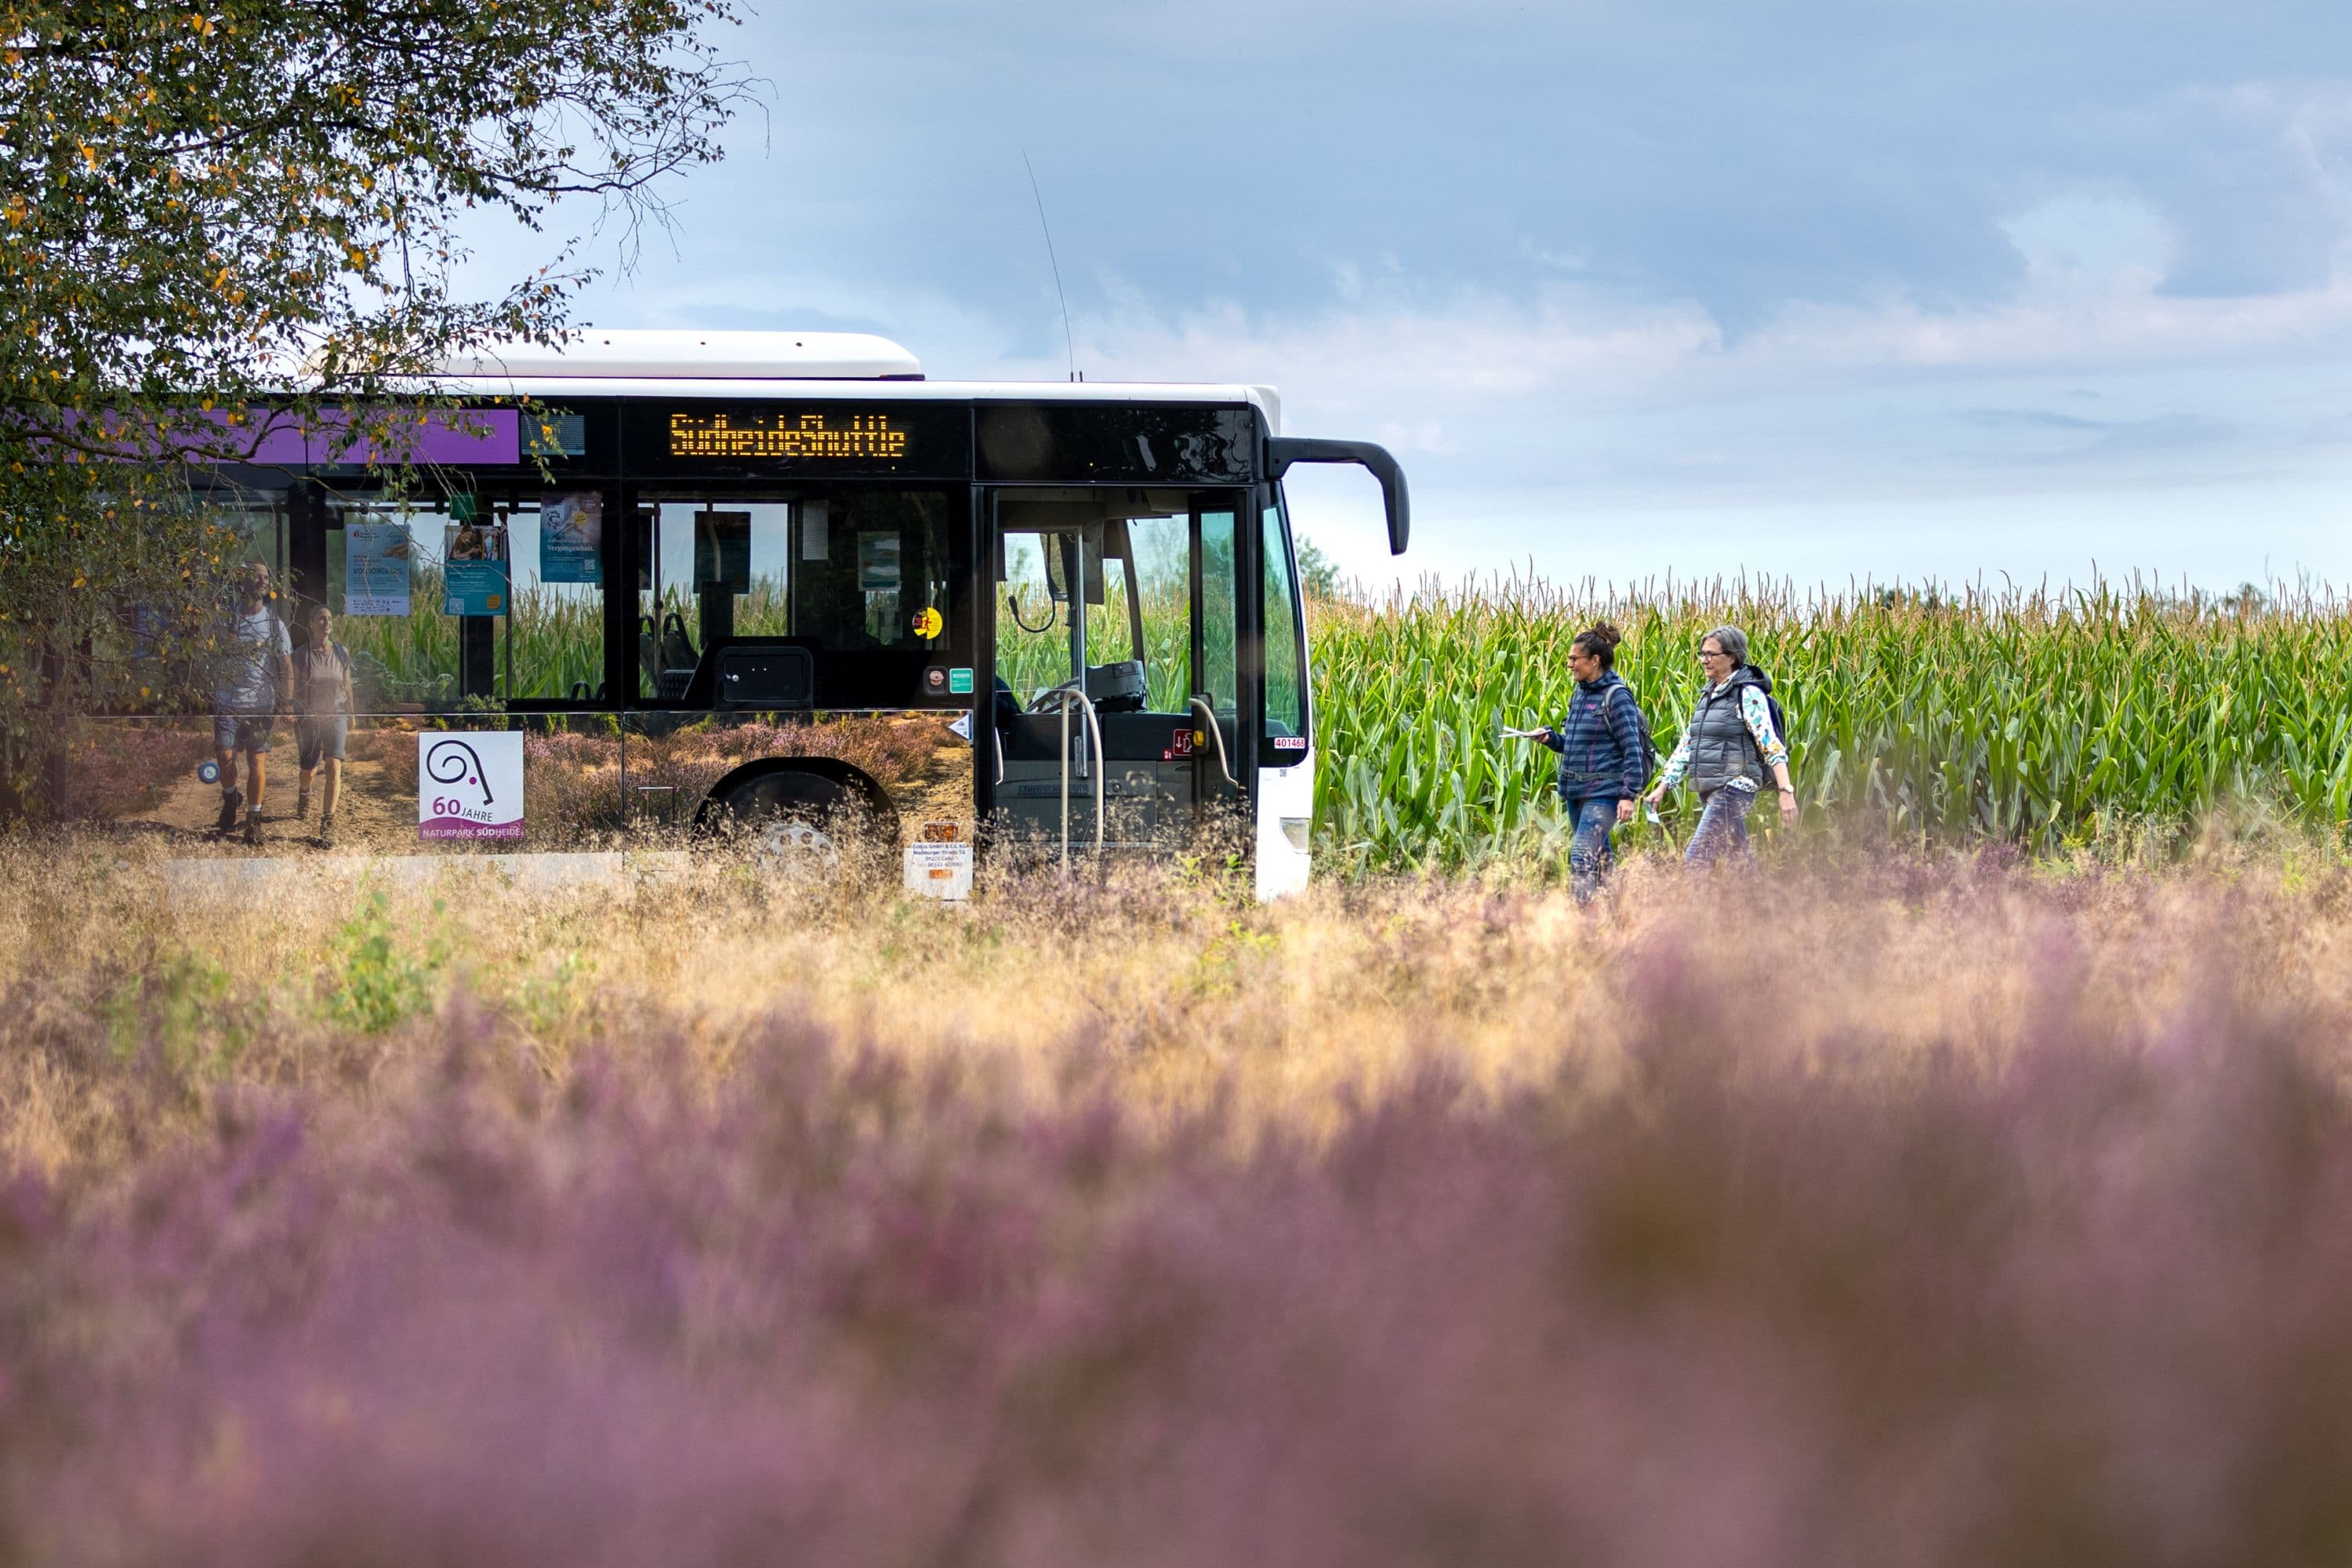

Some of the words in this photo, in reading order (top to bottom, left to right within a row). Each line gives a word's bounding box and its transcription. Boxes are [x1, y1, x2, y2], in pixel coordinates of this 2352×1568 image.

[1276, 739, 1305, 747] 401468
[433, 796, 461, 815] 60
[461, 808, 493, 822] JAHRE
[476, 827, 521, 836] SÜDHEIDE
